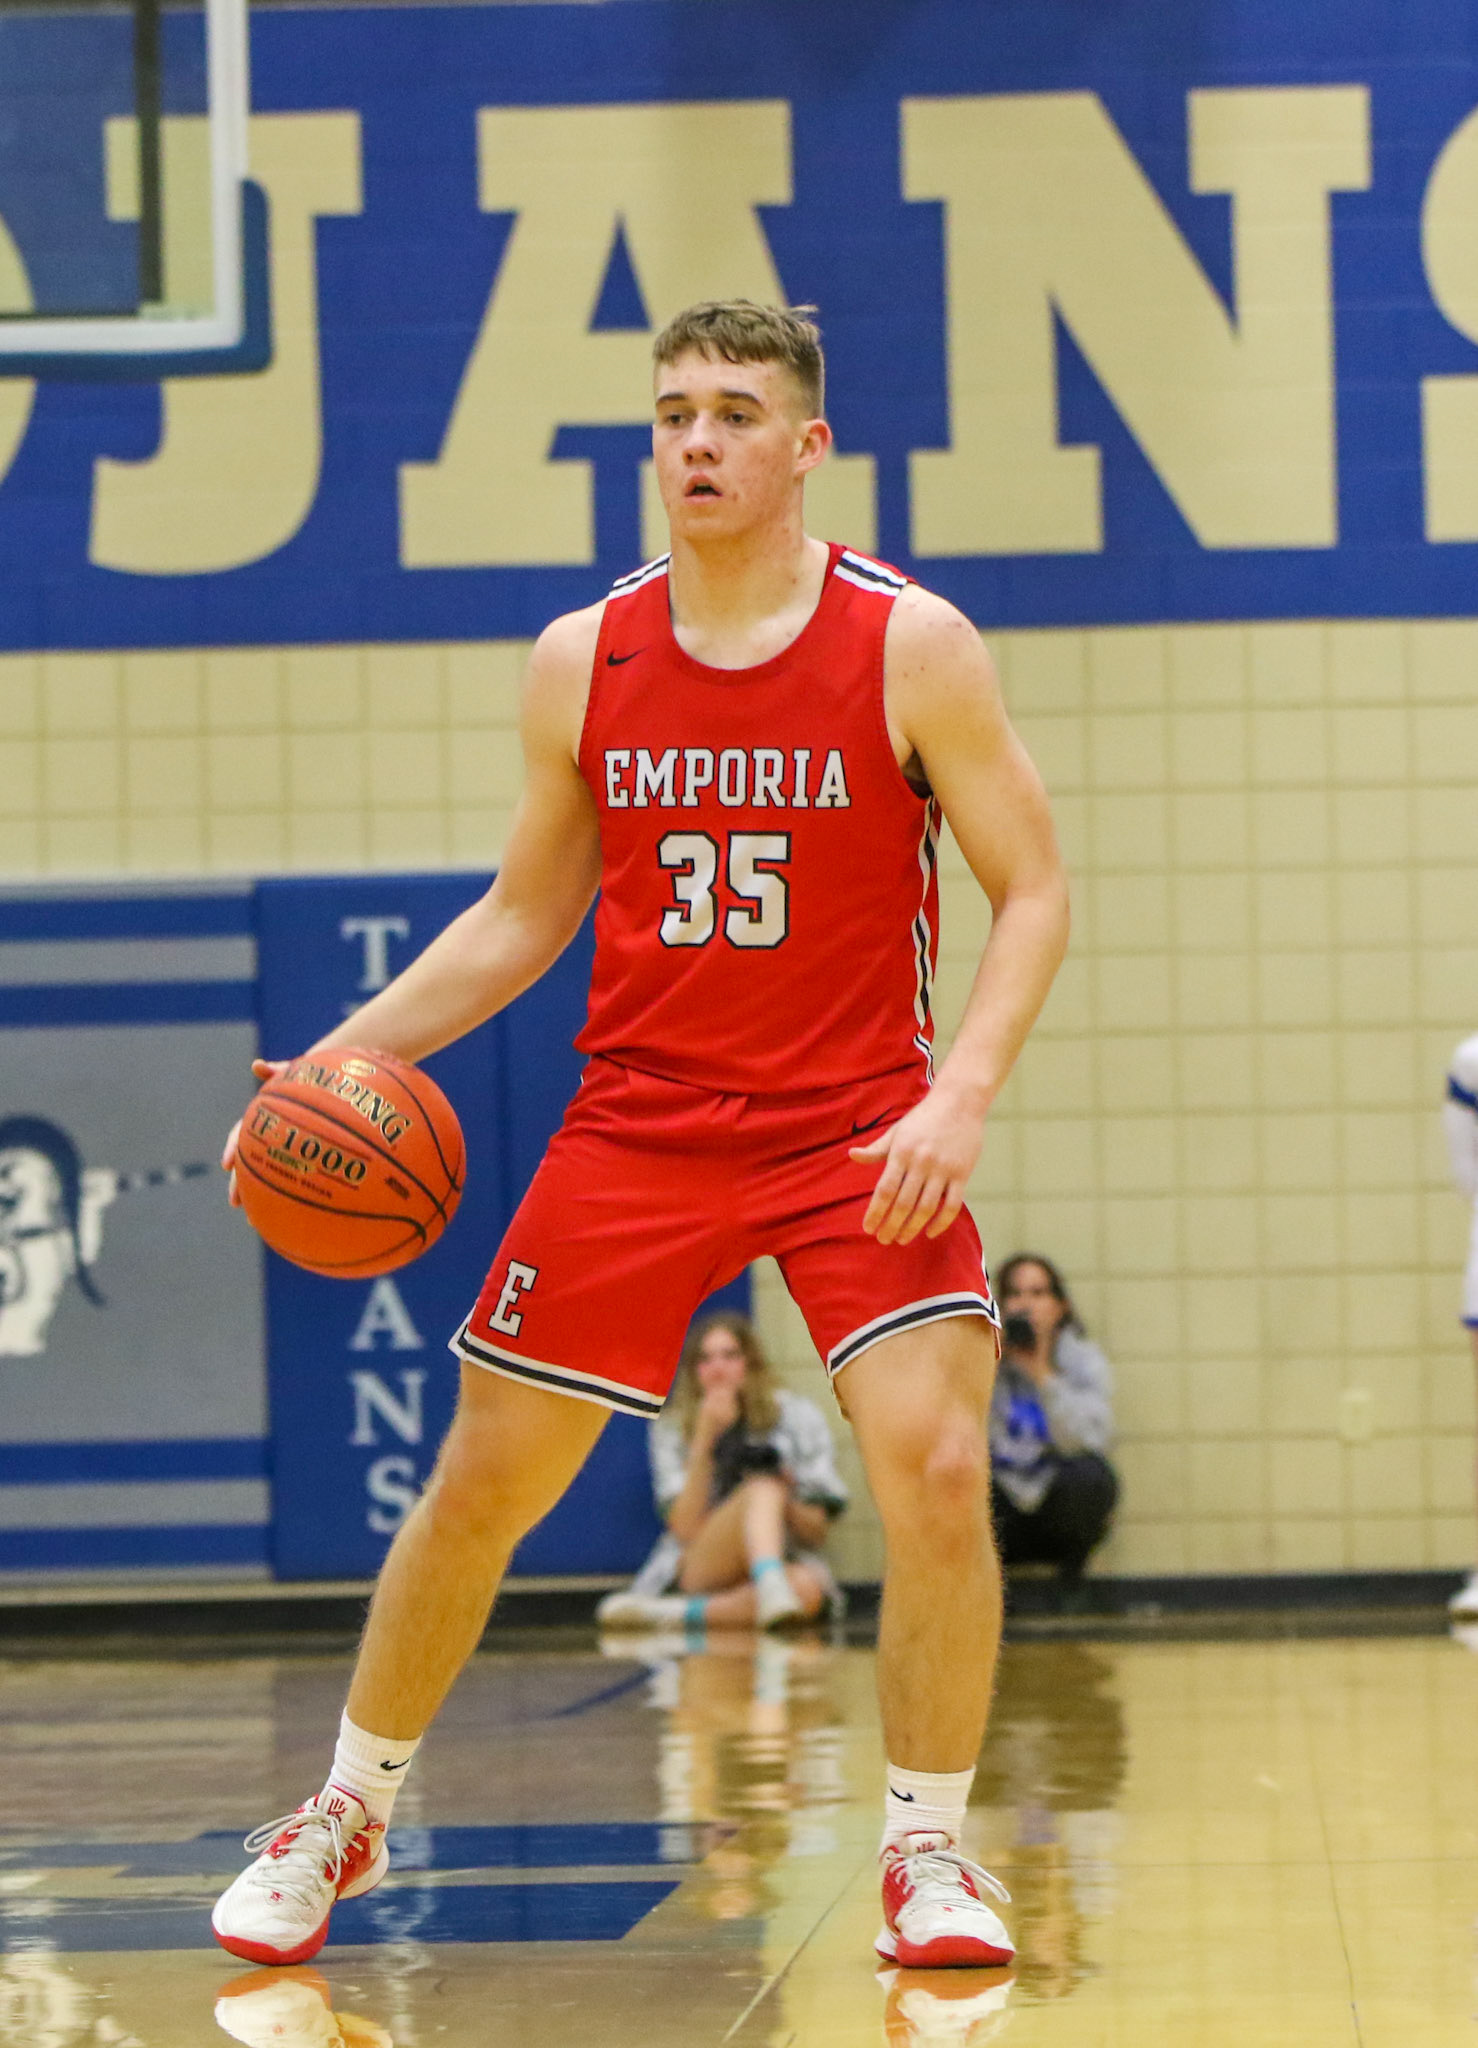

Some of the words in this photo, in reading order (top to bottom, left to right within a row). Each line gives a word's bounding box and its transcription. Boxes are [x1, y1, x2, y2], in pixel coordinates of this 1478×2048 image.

[604, 748, 851, 808] EMPORIA
[656, 830, 792, 949] 35
[487, 1258, 539, 1338] E
